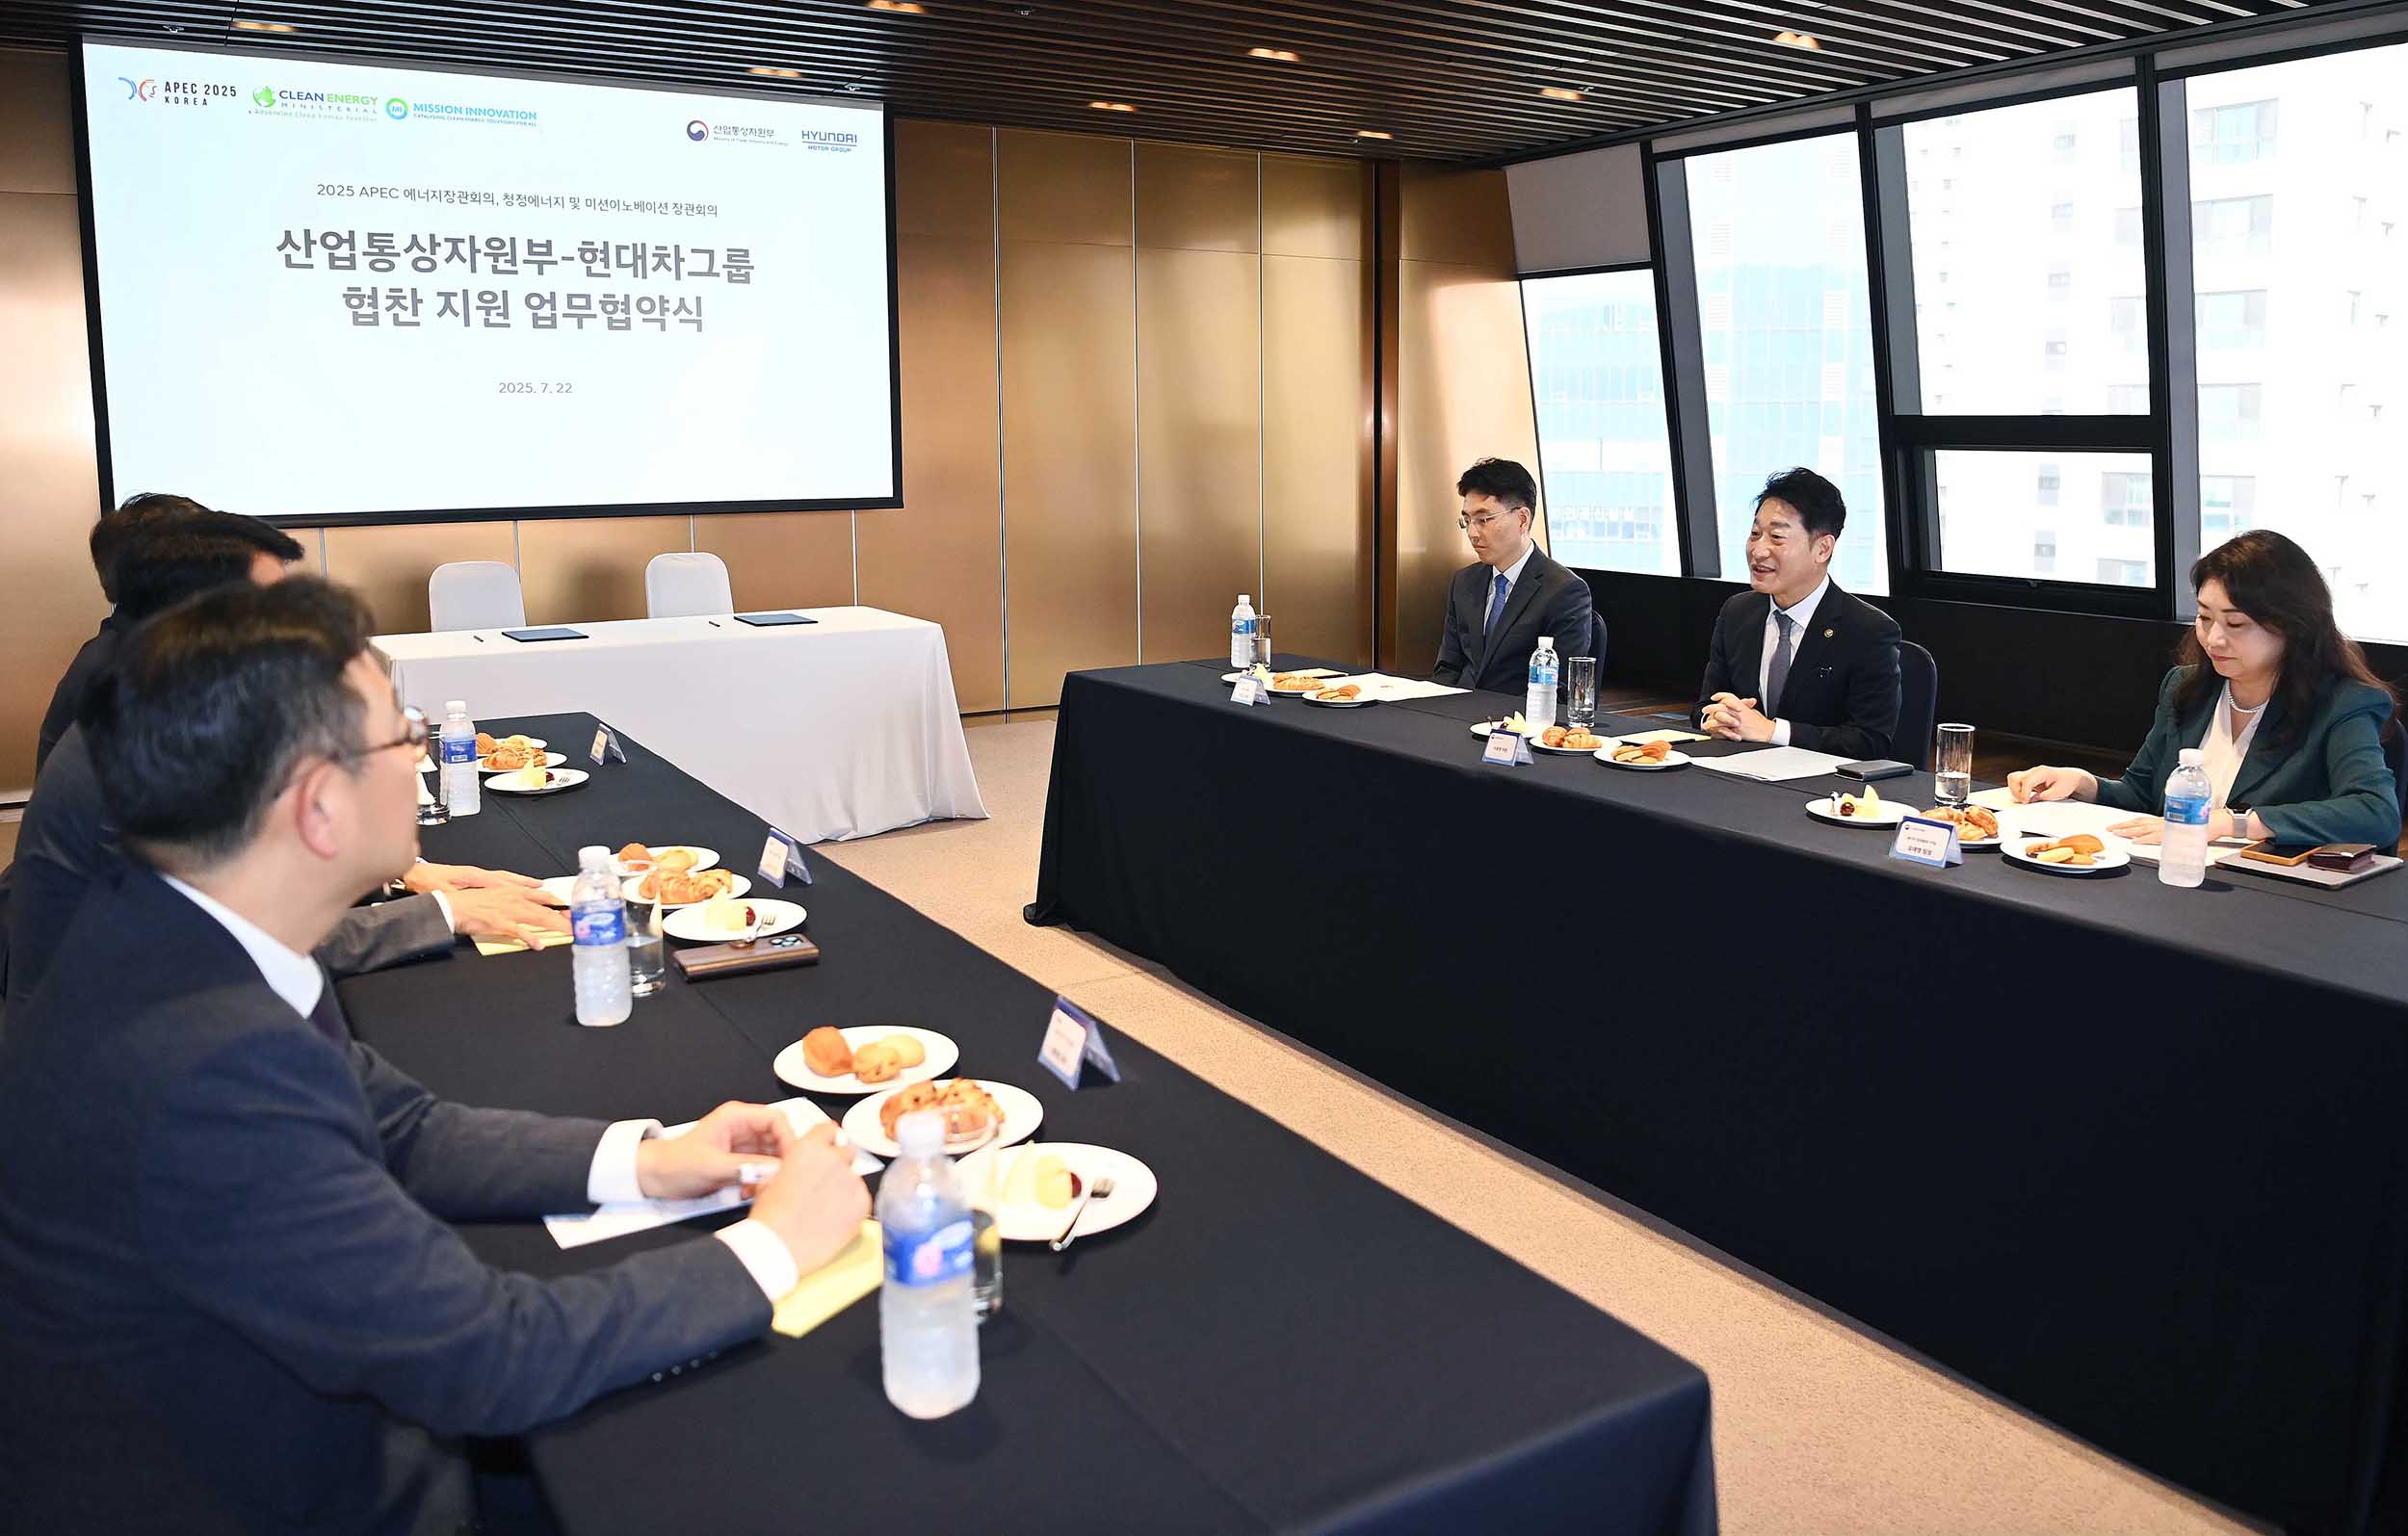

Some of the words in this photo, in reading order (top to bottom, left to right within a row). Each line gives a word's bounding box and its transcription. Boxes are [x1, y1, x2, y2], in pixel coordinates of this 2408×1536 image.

[165, 81, 197, 94] APEC
[204, 84, 237, 97] 2025
[165, 96, 208, 107] KOREA
[278, 90, 325, 102] CLEAN
[327, 92, 379, 106] ENERGY
[281, 102, 378, 114] MINISTERIAL
[413, 102, 462, 115] MISSION
[465, 106, 537, 120] INNOVATION
[713, 124, 775, 139] 산업통상자원부
[801, 129, 857, 143] HYUNDAI
[317, 184, 354, 197] 2025
[359, 186, 400, 199] APEC
[403, 188, 499, 207] 에너지장관회의,
[502, 192, 565, 210] 청정에너지
[568, 195, 581, 210] 및
[585, 196, 668, 215] 미션이노베이션
[671, 200, 719, 218] 장관회의
[275, 227, 755, 285] 산업통상자원부-현대차그룹
[342, 285, 424, 328] 협찬
[436, 288, 511, 329] 지원
[524, 290, 703, 333] 업무협약식
[498, 382, 537, 395] 2025.
[556, 382, 573, 395] 22
